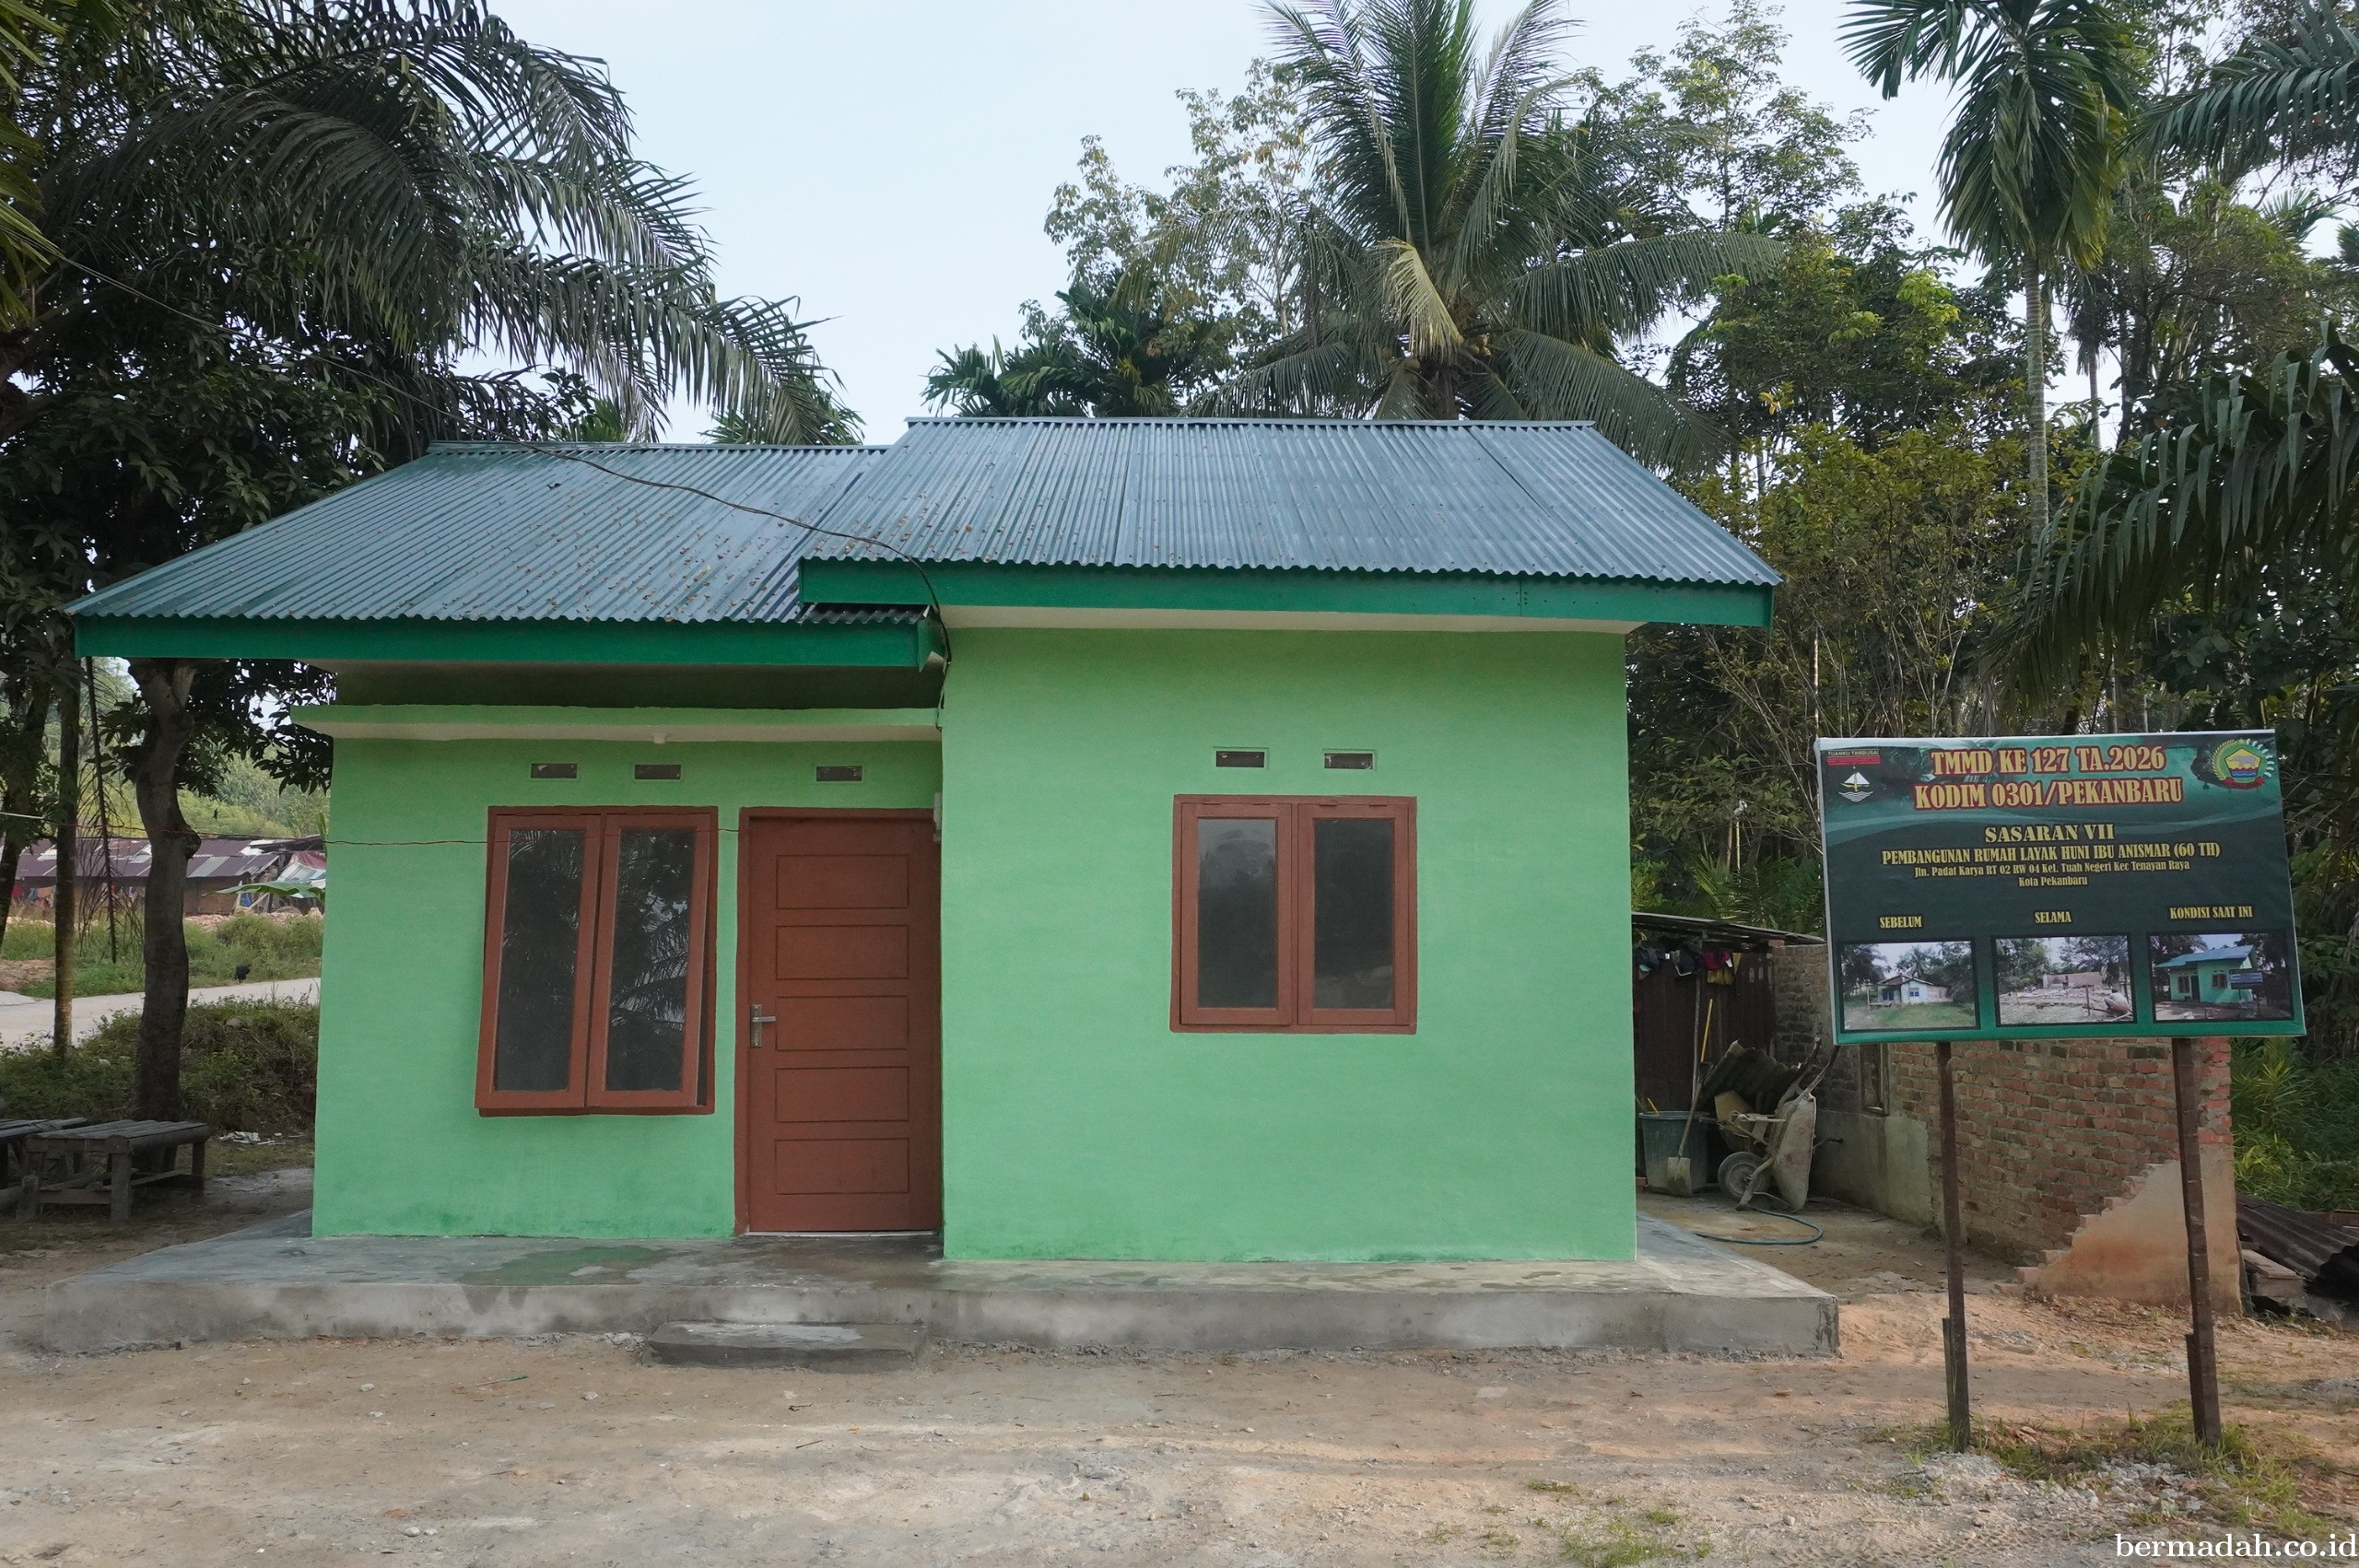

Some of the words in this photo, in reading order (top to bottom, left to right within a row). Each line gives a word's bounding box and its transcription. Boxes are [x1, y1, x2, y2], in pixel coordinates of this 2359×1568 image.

[1931, 750, 1992, 775] TMMD
[1999, 749, 2026, 773] KE
[2031, 748, 2071, 772] 127
[2076, 746, 2165, 771] TA.2026
[1915, 784, 1986, 809] KODIM
[1991, 778, 2182, 807] 0301/PEKANBARU
[1985, 825, 2079, 843] SASARAN
[2083, 824, 2115, 840] VII
[1882, 848, 1971, 865] PEMBANGUNAN
[1974, 848, 2016, 862] RUMAH
[2020, 847, 2058, 861] LAYAK
[2060, 845, 2090, 860] HUNI
[2094, 845, 2115, 859] IBU
[2118, 843, 2171, 859] ANISMAR
[2174, 842, 2194, 859] (60
[2198, 841, 2221, 858] TH)
[1914, 867, 1930, 878] Jln.
[1931, 866, 1957, 877] Padat
[1959, 865, 1984, 876] Karya
[1986, 865, 1997, 874] RT
[2000, 864, 2011, 874] 02
[2013, 864, 2026, 874] RW
[2028, 864, 2040, 873] 04
[2042, 863, 2059, 873] Kel.
[2060, 862, 2083, 872] Tuah
[2084, 861, 2112, 873] Negeri
[2114, 861, 2130, 872] Kec
[2131, 860, 2166, 872] Tenayan
[2168, 860, 2189, 872] Raya
[2019, 877, 2038, 887] Kota
[2041, 876, 2088, 886] Pekanbaru
[2035, 911, 2071, 923] SELAMA
[2169, 907, 2211, 919] KONDISI
[2212, 906, 2236, 919] SAAT
[2238, 906, 2253, 918] INI
[1879, 916, 1922, 929] SEBELUM
